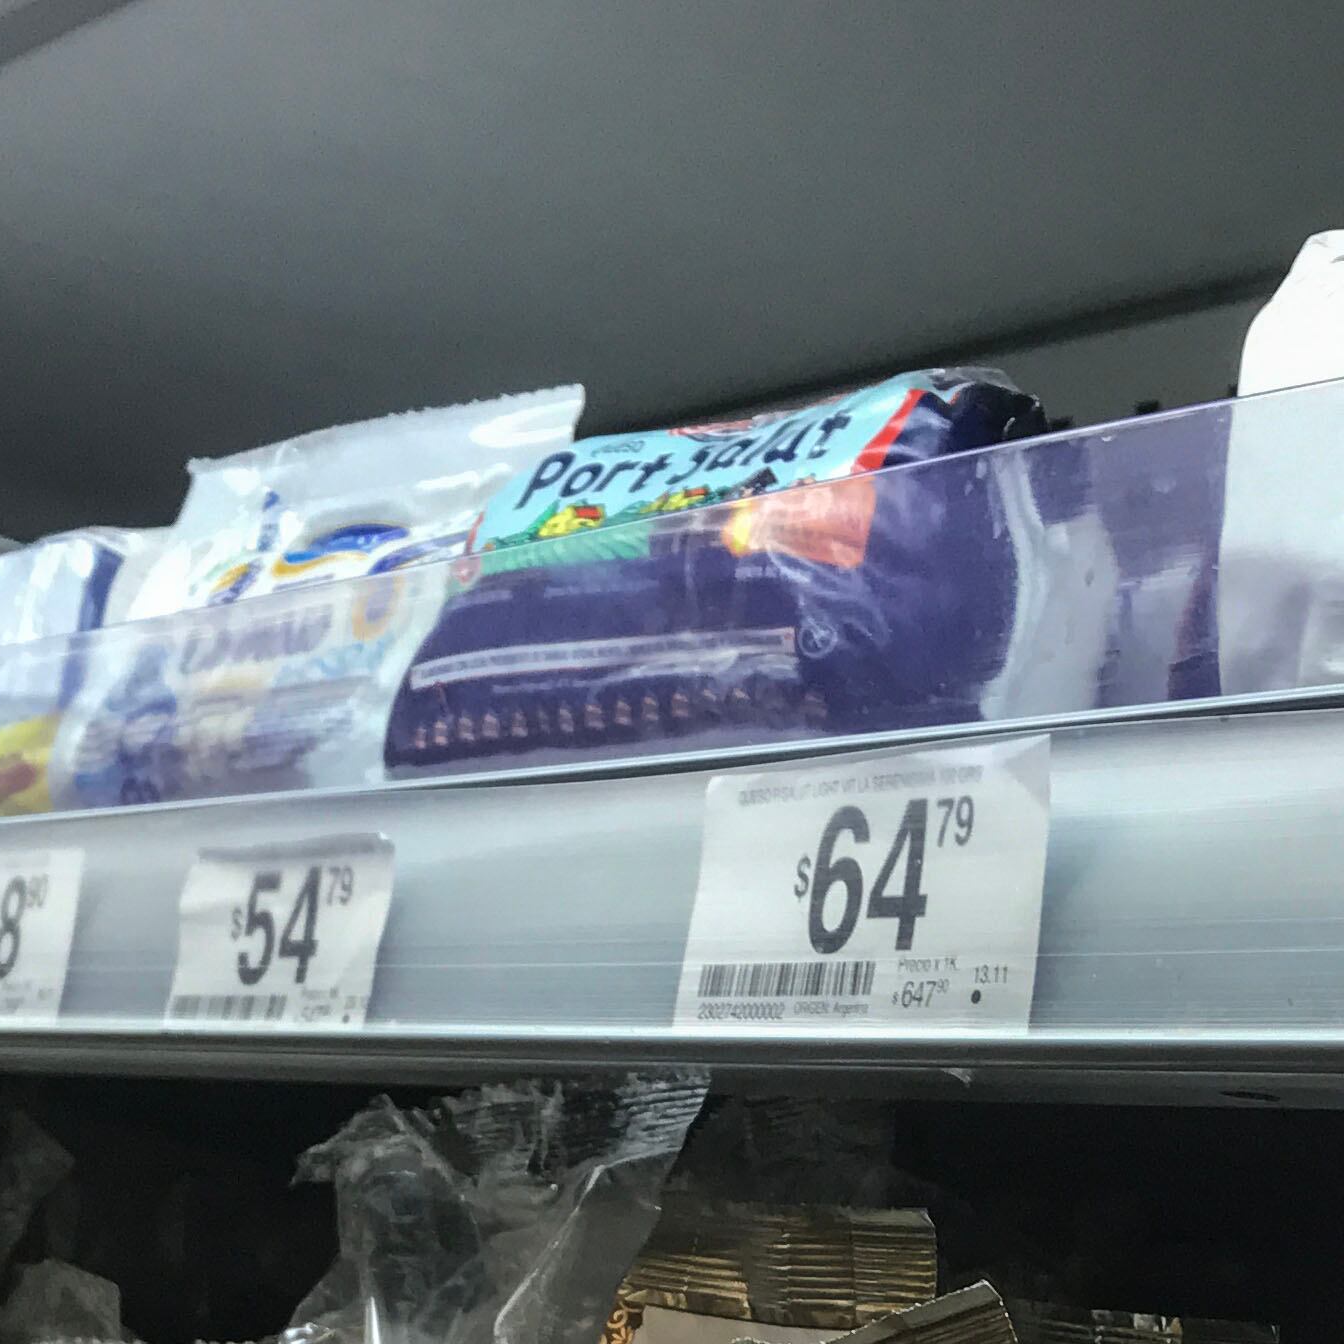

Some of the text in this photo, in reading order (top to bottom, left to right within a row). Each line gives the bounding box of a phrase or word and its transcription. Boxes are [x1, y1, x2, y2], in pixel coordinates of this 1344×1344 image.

[514, 450, 674, 511] Port
[794, 794, 976, 955] $ 64 79
[238, 865, 322, 985] 54
[326, 865, 354, 906] 79
[901, 979, 937, 1009] 647
[973, 964, 1009, 986] 13.11
